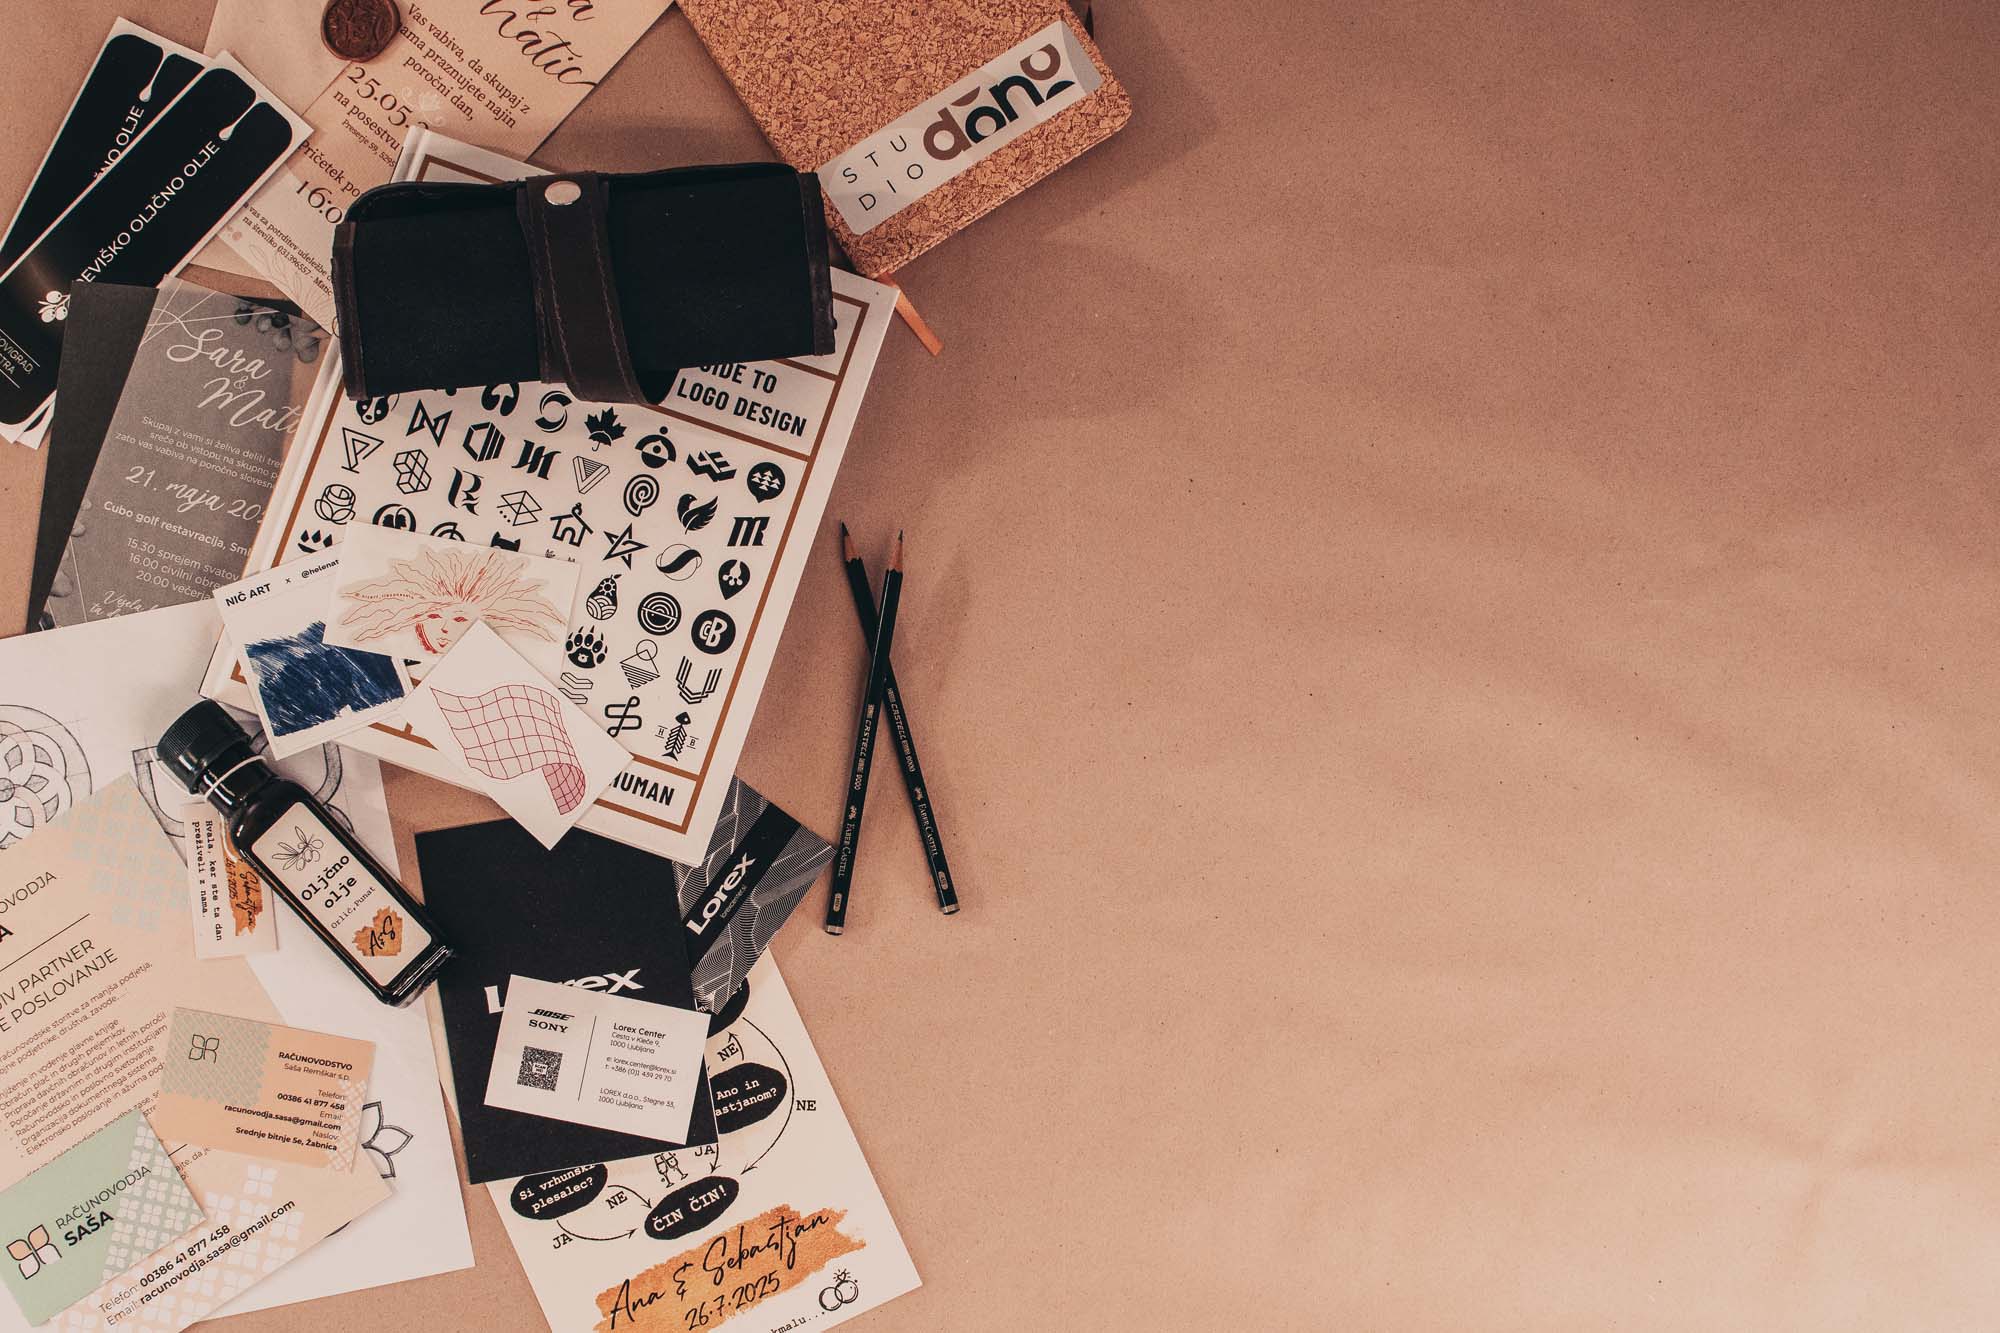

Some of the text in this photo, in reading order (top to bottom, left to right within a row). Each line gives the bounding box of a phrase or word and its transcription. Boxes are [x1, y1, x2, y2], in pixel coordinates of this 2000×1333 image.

[408, 3, 531, 115] Vas vabiva, da skupaj z
[402, 56, 473, 121] poročni dan,
[422, 48, 516, 129] praznujete najin
[116, 106, 144, 146] OLJE
[333, 91, 400, 151] na posestvu
[342, 119, 369, 145] Preserje
[297, 139, 345, 184] Pričetek
[130, 177, 184, 232] OLJČNO
[184, 141, 220, 177] OLJE
[296, 181, 352, 224] 16:0
[248, 205, 327, 276] vas potrditev udeležbe
[252, 223, 336, 296] številko 031396557 Matic
[0, 336, 34, 374] OVIGRAD,
[166, 329, 272, 378] Sara
[700, 363, 747, 385] IDE
[752, 369, 777, 394] TO
[677, 377, 807, 437] LOGO DESIGN
[114, 431, 238, 477] zato vas vabiva poročno
[141, 416, 266, 463] Skupaj vami želiva deliti
[149, 432, 267, 475] sreče vstopu skupno
[125, 466, 225, 513] 21. maja
[104, 501, 226, 550] Cubo golf restavracija,
[127, 537, 156, 554] 15.30
[157, 549, 201, 569] sprejem
[129, 552, 193, 580] 16.00 civilni
[136, 570, 169, 588] 20.00
[225, 559, 339, 607] NIČ ART @helenat
[192, 821, 205, 873] preživeli
[204, 819, 216, 854] Hvala,
[0, 872, 57, 914] OVODJA
[301, 855, 349, 901] Oljčno
[324, 877, 357, 908] olje
[682, 853, 756, 935] Lorex
[11, 948, 118, 1023] POSLOVANJE
[18, 939, 95, 993] PARTNER
[484, 968, 645, 1014] Lex
[527, 1008, 576, 1022] BOSE
[529, 1019, 568, 1033] SONY
[612, 1021, 667, 1040] Lorex Center
[610, 1030, 631, 1042] Cesta
[717, 1042, 739, 1062] NE
[278, 1052, 353, 1071] RAČUNOVODSTVO
[302, 1065, 338, 1079] Remškar
[276, 1092, 303, 1104] 00386
[713, 1087, 777, 1116] astjanom?
[716, 1079, 761, 1100] Ano in
[795, 1099, 817, 1112] NE
[224, 1105, 341, 1131] racunovodja.sasa@gmail.com
[234, 1126, 267, 1140] Srednje
[266, 1131, 292, 1144] bitnje
[305, 1138, 337, 1151] Žabnica
[694, 1142, 716, 1157] JA
[55, 1166, 151, 1230] RAČUNOVODJA
[518, 1187, 536, 1201] Si
[531, 1177, 593, 1214] plesalec?
[605, 1191, 628, 1209] NE
[652, 1184, 727, 1231] ČIN ČIN!
[64, 1211, 114, 1246] SAŠA
[553, 1231, 573, 1249] JA
[140, 1201, 295, 1305] racunovodja.sasa@gmail.com
[140, 1261, 174, 1287] 00386
[175, 1251, 188, 1265] 41
[187, 1238, 207, 1256] 877
[210, 1225, 230, 1242] 458
[610, 1279, 665, 1330] Ana
[702, 1215, 829, 1291] Sebastjan
